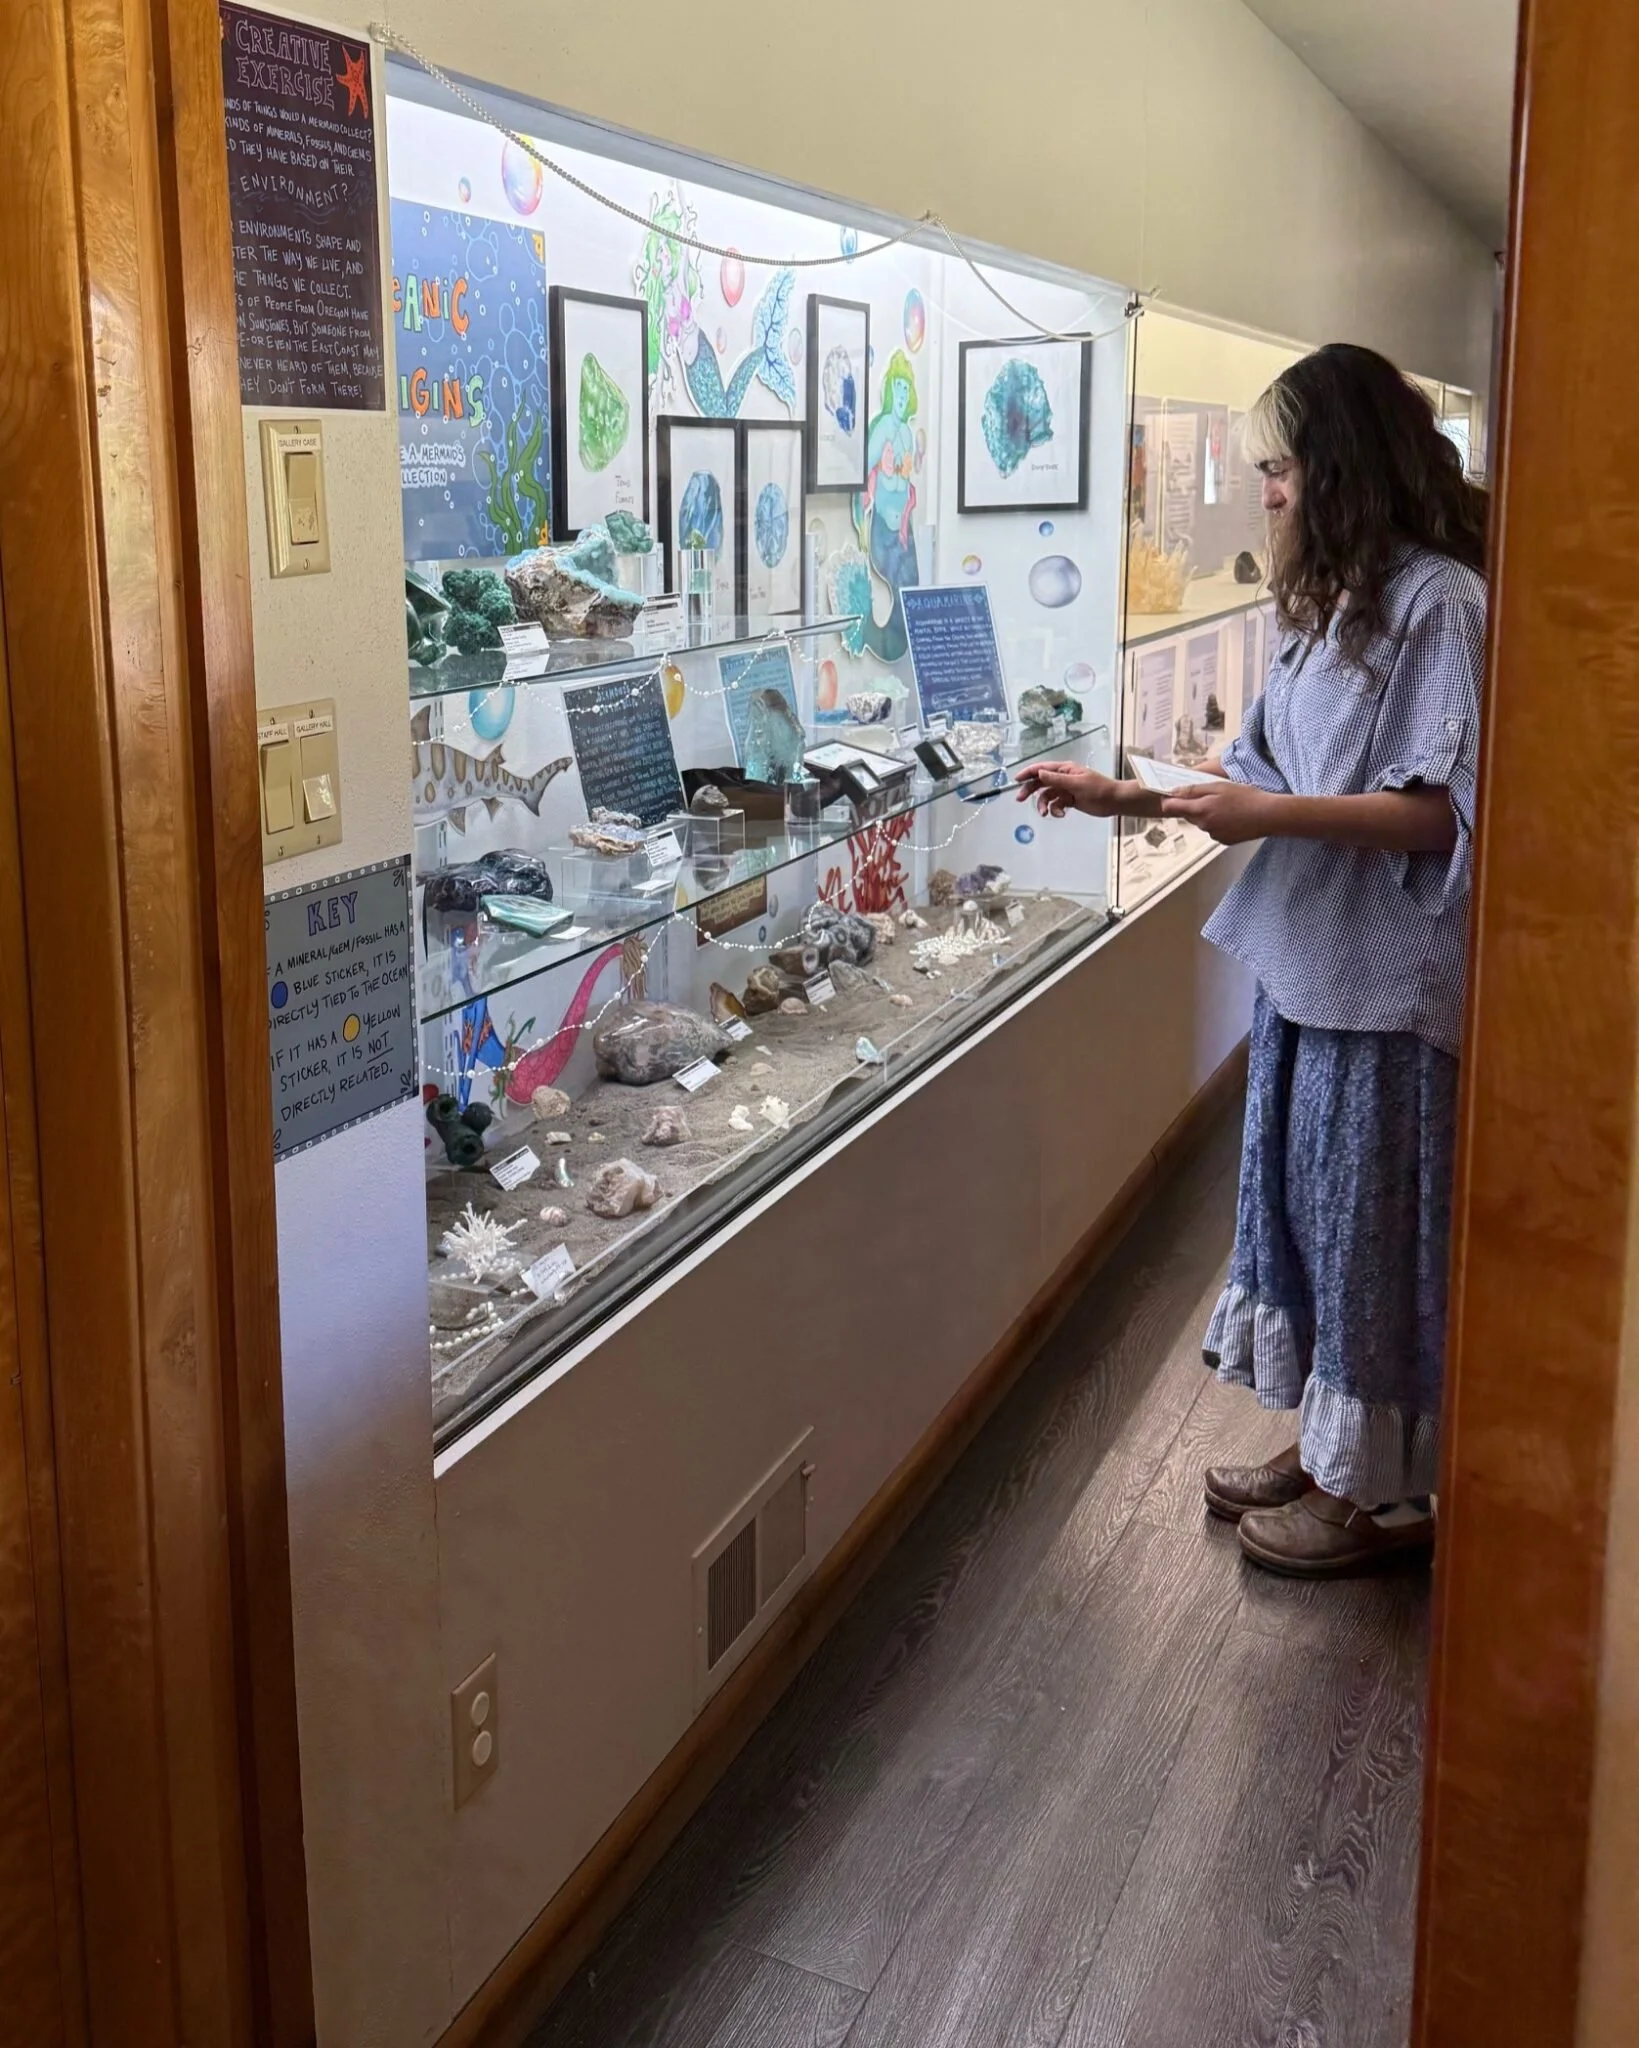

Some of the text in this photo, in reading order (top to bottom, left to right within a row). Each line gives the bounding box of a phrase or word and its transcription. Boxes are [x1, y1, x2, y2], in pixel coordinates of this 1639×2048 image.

[235, 19, 332, 74] CREATIVE
[236, 56, 334, 110] EXERCISE
[225, 98, 372, 143] INDS OF THINGS WOULD A MERMAID COLLECT?
[240, 140, 262, 162] THEY
[266, 146, 288, 164] HAVE
[290, 151, 318, 168] BASED
[319, 158, 329, 169] ON
[332, 159, 355, 176] THEIR
[254, 123, 264, 133] OF
[267, 125, 305, 149] MINERALS,
[334, 142, 347, 156] AND
[348, 147, 371, 161] GEMS
[239, 220, 312, 245] ENVIRONMENTS
[316, 234, 342, 250] SHAPE
[346, 238, 361, 252] AND
[232, 245, 363, 279] TER THE WAY WE LIVE, AND
[233, 268, 351, 299] HE THINGS WE COLLECT.
[248, 296, 259, 307] OF
[265, 296, 293, 311] PEOPLE
[295, 299, 314, 315] FROM
[317, 300, 348, 320] OREGON
[351, 308, 368, 320] HAVE
[249, 313, 291, 335] SUNSTONES,
[293, 320, 308, 335] BUT
[312, 322, 347, 337] SOMEONE
[349, 327, 371, 340] FROM
[267, 335, 291, 352] EVEN
[292, 340, 308, 352] THE
[312, 339, 332, 355] EAST
[334, 341, 360, 357] COAST
[363, 345, 379, 360] MAY
[240, 356, 383, 379] NEVER HEARD OF THEM, BECAUSE
[240, 375, 259, 393] HEY
[300, 379, 326, 395] FORM
[330, 382, 362, 398] THERE!
[400, 367, 485, 428] IGINS
[410, 447, 416, 460] A
[402, 471, 445, 484] LLECTION
[307, 891, 358, 936] KEY
[275, 963, 283, 977] A
[384, 925, 399, 937] HAS
[399, 921, 405, 933] A
[293, 950, 396, 995] BLUE STICKER, IT IS
[321, 992, 346, 1008] TIED
[347, 985, 359, 1000] TO
[361, 979, 380, 996] THE
[382, 964, 408, 985] OCEAN
[271, 1004, 401, 1071] IF IT HAS A YELLOW
[280, 1031, 389, 1093] STICKER, IT IS NOT
[281, 1062, 393, 1121] DIRECTLY RELATED.
